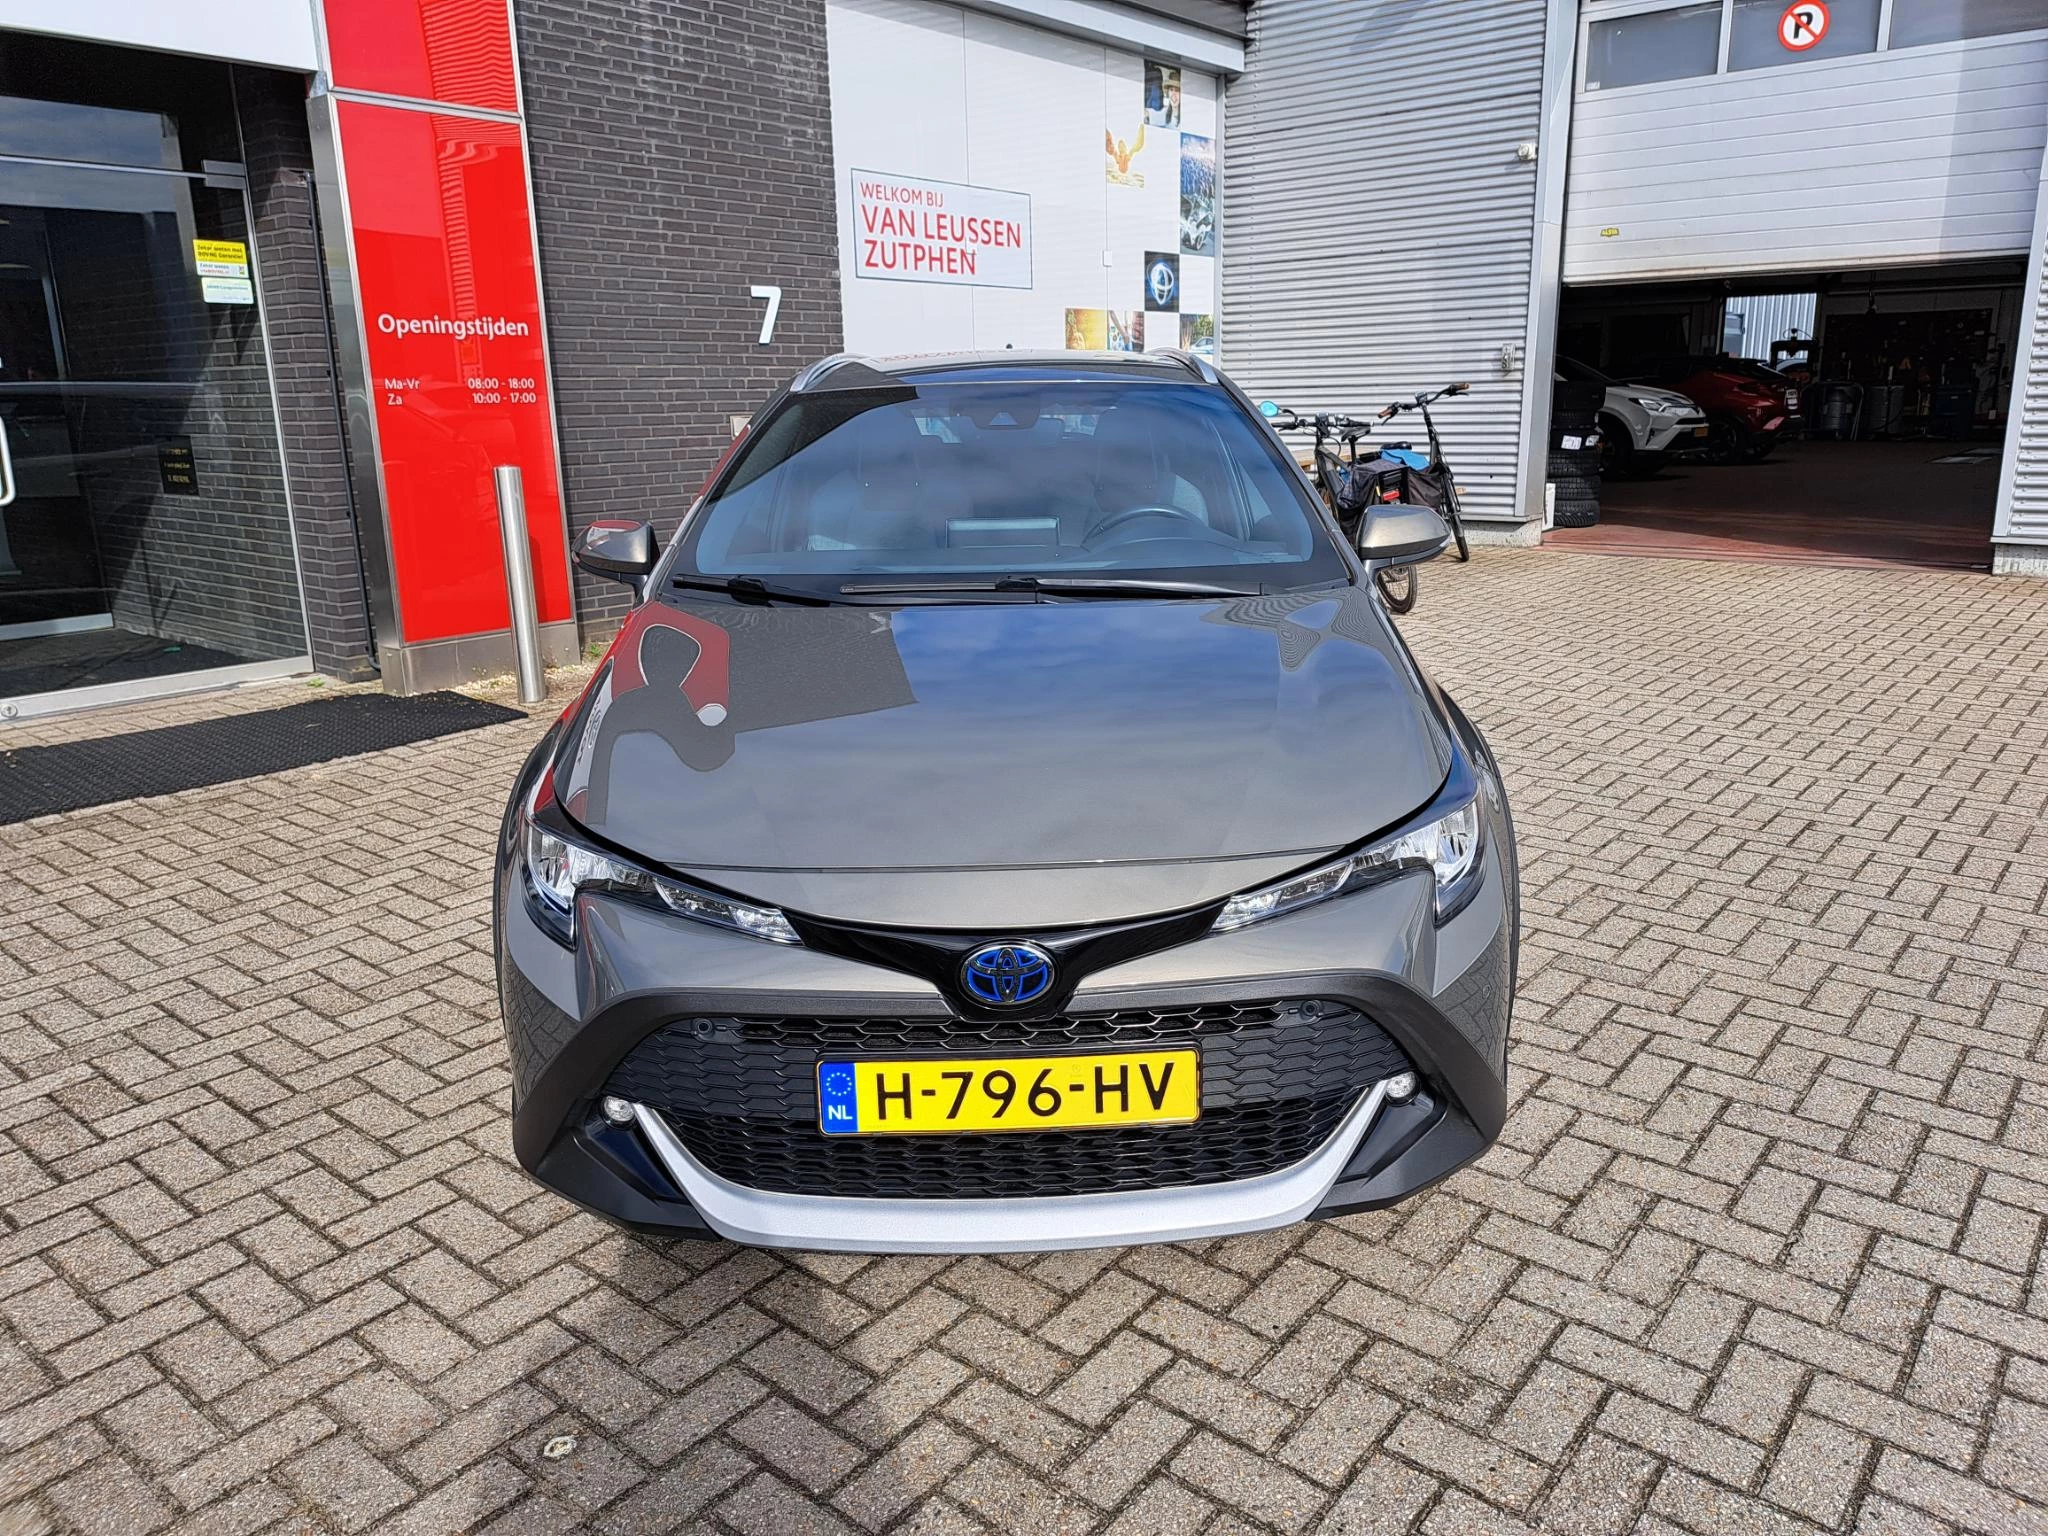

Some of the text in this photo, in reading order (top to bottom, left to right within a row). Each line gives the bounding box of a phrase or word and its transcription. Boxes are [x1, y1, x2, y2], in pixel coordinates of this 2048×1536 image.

[1793, 11, 1813, 39] P
[860, 182, 944, 208] WELKOM BIJ
[861, 204, 1021, 249] VAN LEUSSEN
[864, 239, 976, 275] ZUTPHEN
[377, 313, 529, 341] Openingstijden
[750, 285, 782, 344] 7
[384, 378, 420, 390] Ma-Vr
[467, 377, 499, 389] 08:00
[508, 378, 534, 389] 18:00
[387, 393, 402, 405] Za
[473, 392, 500, 404] 10:00
[510, 392, 537, 404] 17:00
[876, 1062, 1175, 1121] H-796-HV
[827, 1104, 853, 1121] NL
